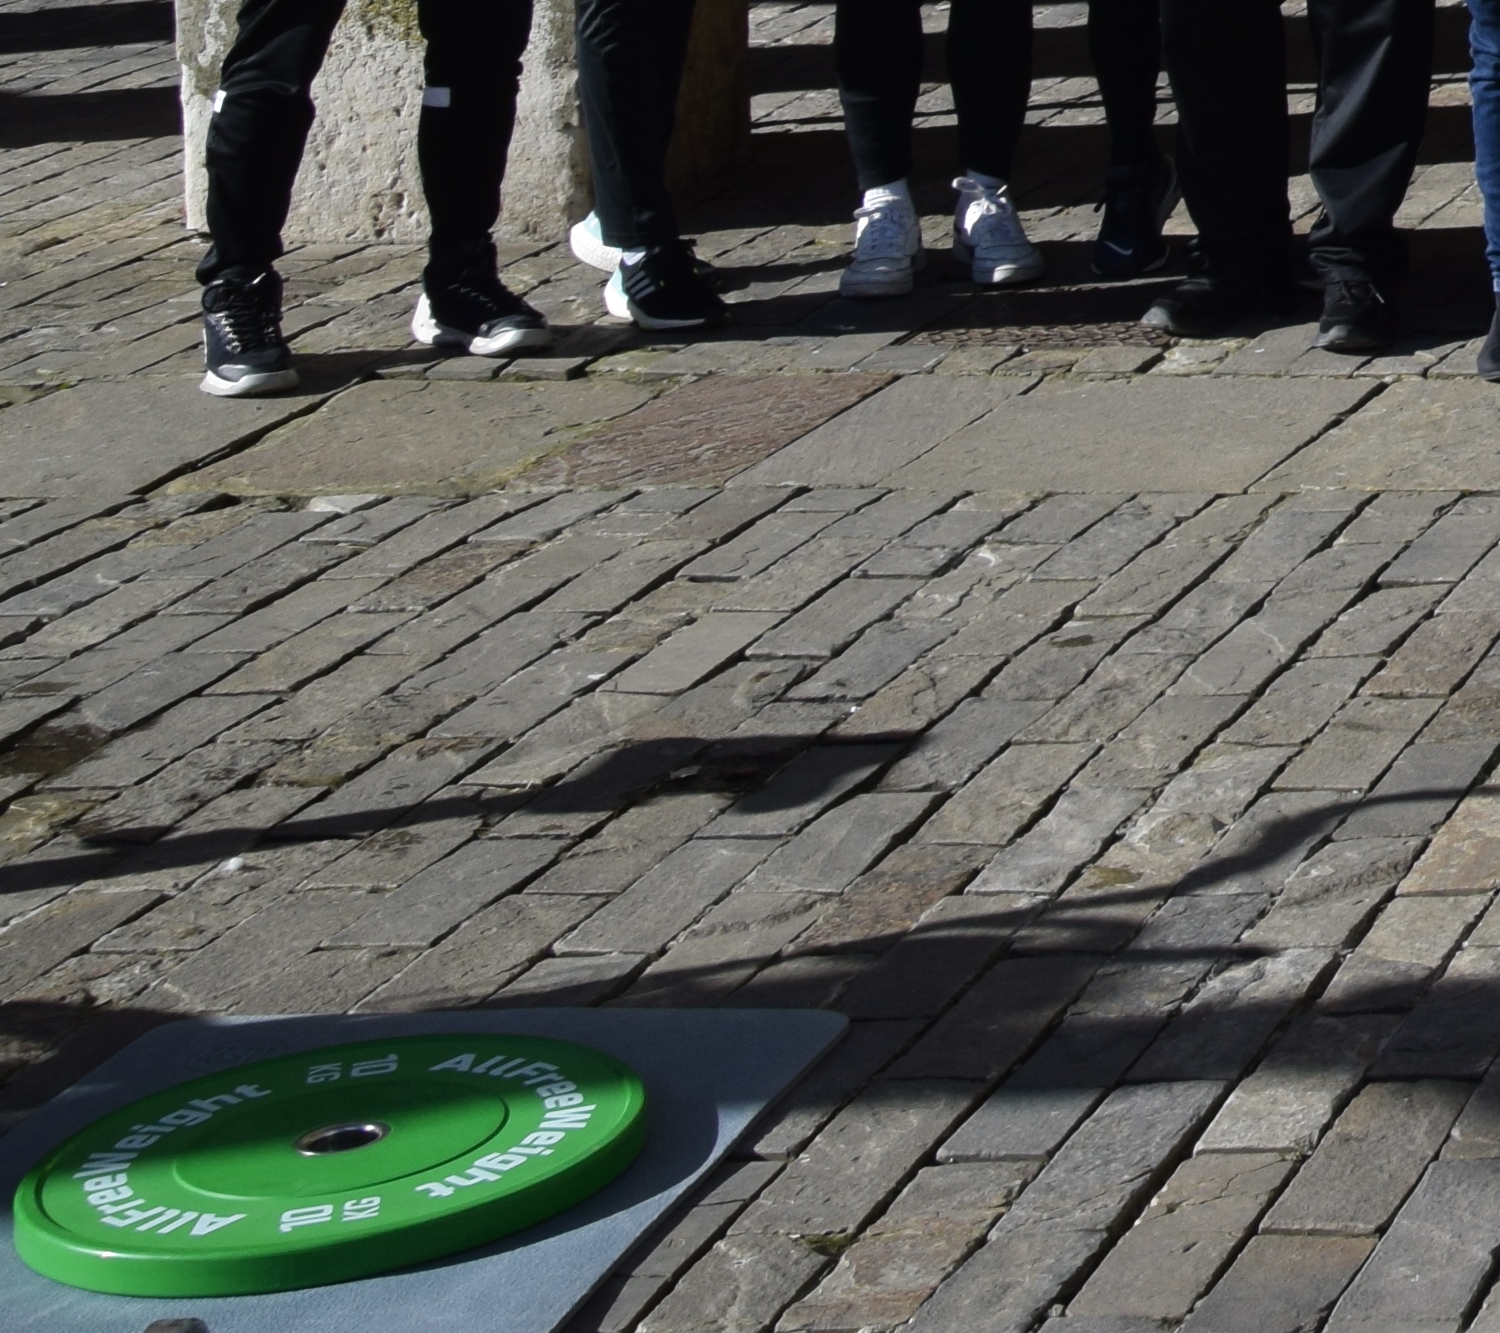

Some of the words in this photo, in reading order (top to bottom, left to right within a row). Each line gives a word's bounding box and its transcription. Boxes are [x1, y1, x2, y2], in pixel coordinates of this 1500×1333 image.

[305, 1062, 344, 1086] KG
[349, 1053, 400, 1079] 10
[413, 1051, 597, 1201] AllFreeWeight
[72, 1081, 273, 1238] AllFreeWeight
[278, 1203, 334, 1233] 10
[341, 1195, 382, 1222] KG
